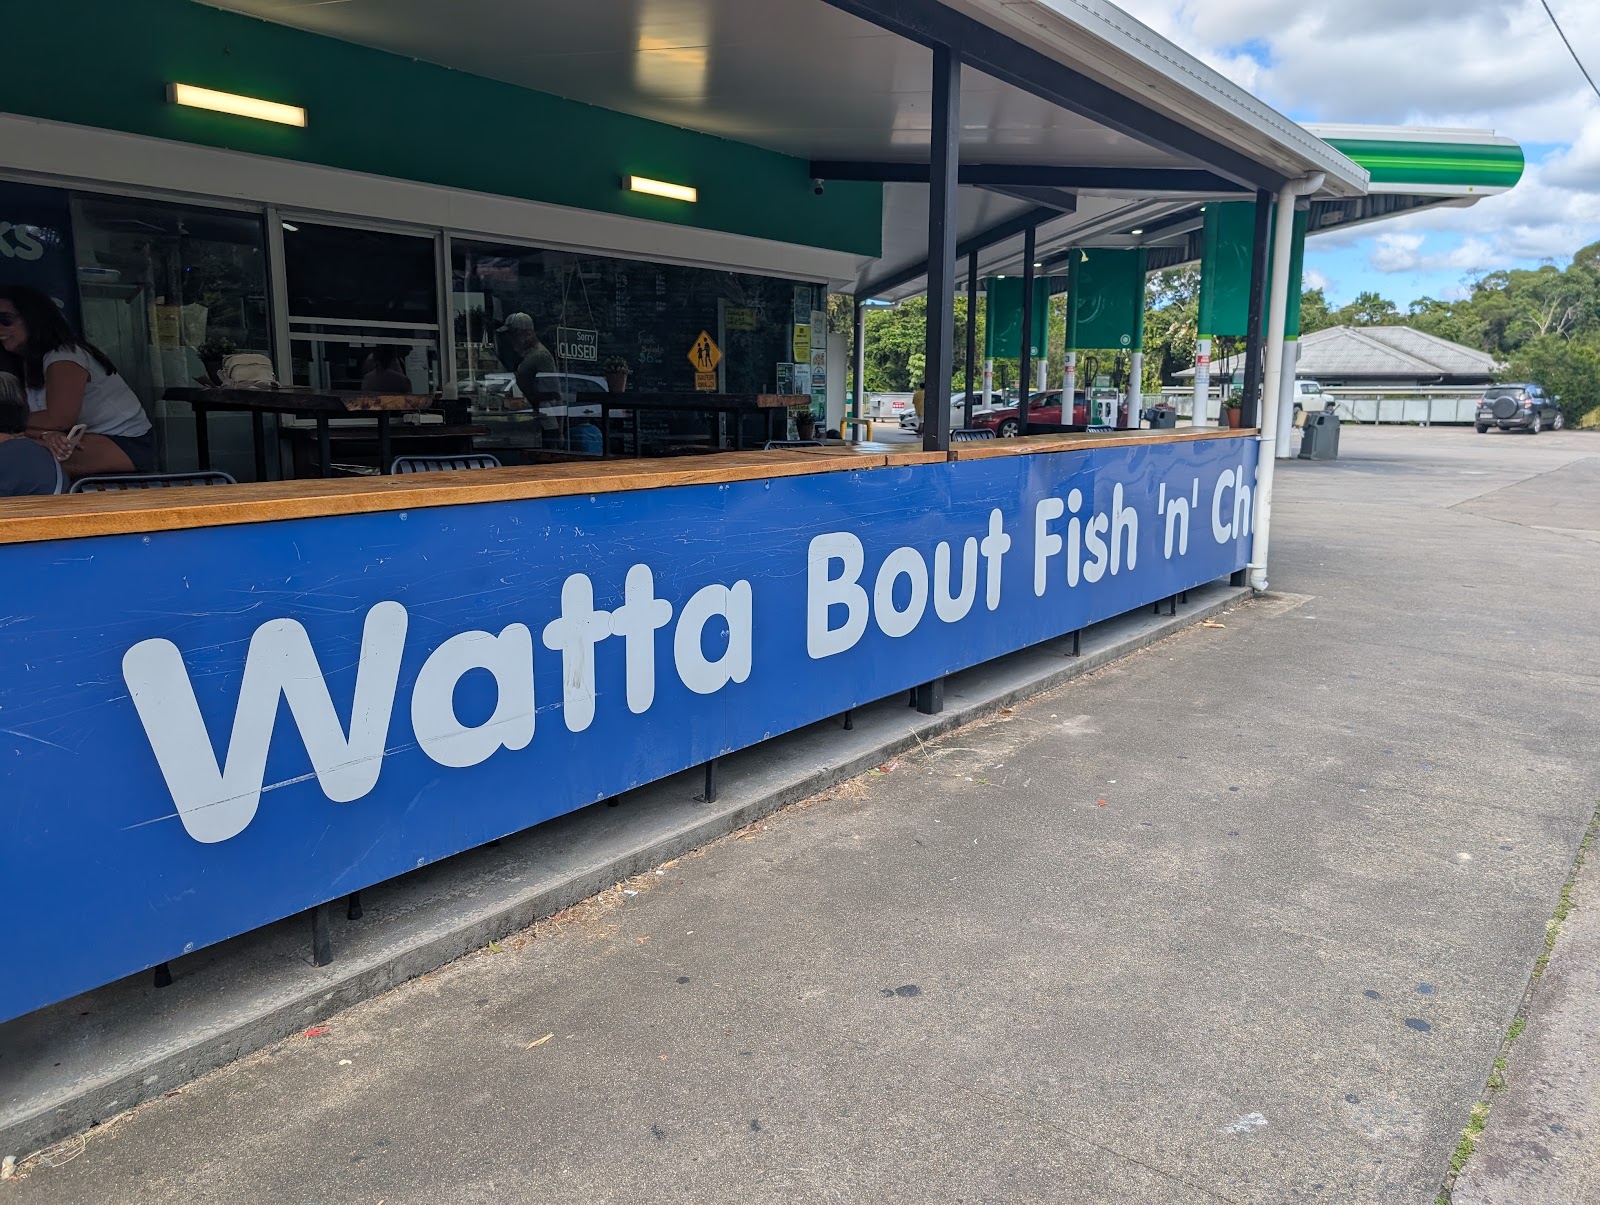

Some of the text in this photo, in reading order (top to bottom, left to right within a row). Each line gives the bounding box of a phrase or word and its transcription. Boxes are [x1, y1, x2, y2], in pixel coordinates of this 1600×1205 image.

[576, 331, 595, 344] Sorry
[559, 342, 596, 359] CLOSED
[1197, 343, 1202, 353] 1
[1065, 355, 1070, 363] 3
[122, 563, 752, 844] Watta
[807, 508, 1011, 660] Bout
[1033, 482, 1138, 597] Fish
[1158, 477, 1199, 560] 'n'
